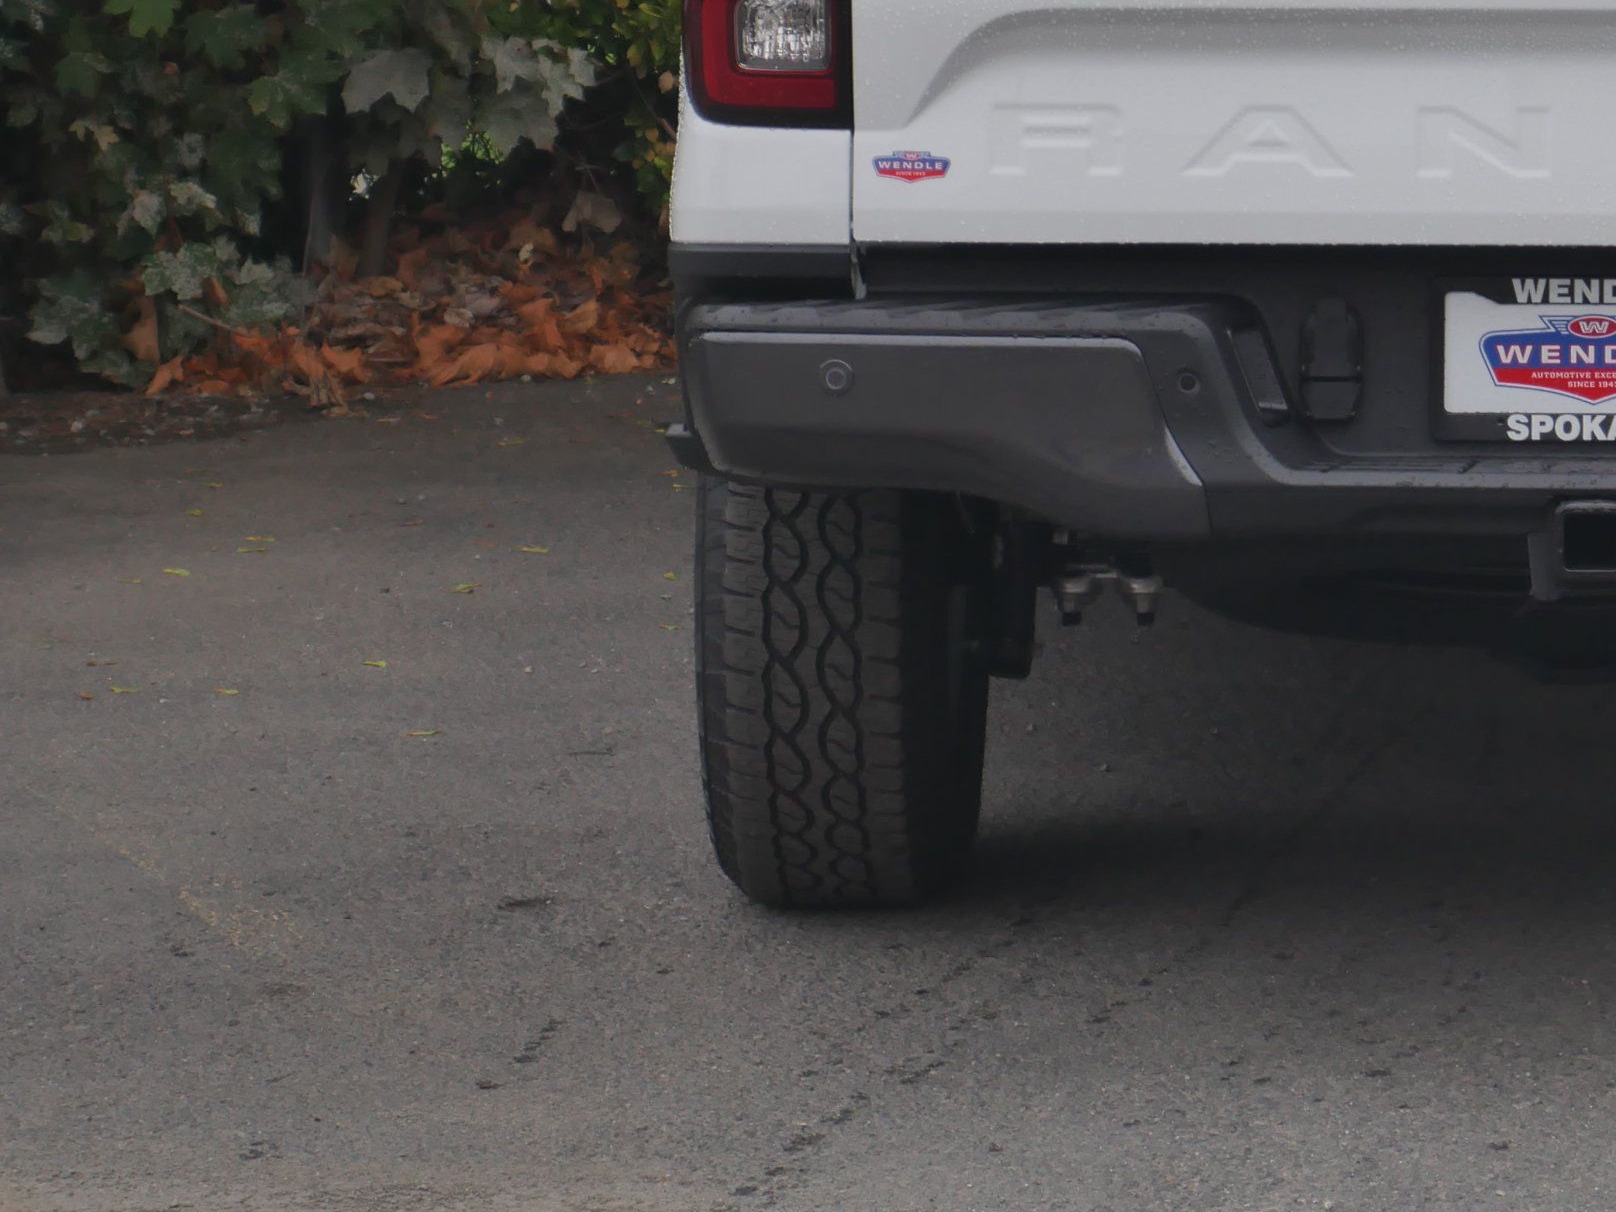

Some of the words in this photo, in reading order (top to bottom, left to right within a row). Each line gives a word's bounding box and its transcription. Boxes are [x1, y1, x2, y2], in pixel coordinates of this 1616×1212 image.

[878, 161, 943, 170] WENDLE
[1531, 371, 1592, 380] AUTOMOTIVE
[1567, 380, 1596, 389] SINCE
